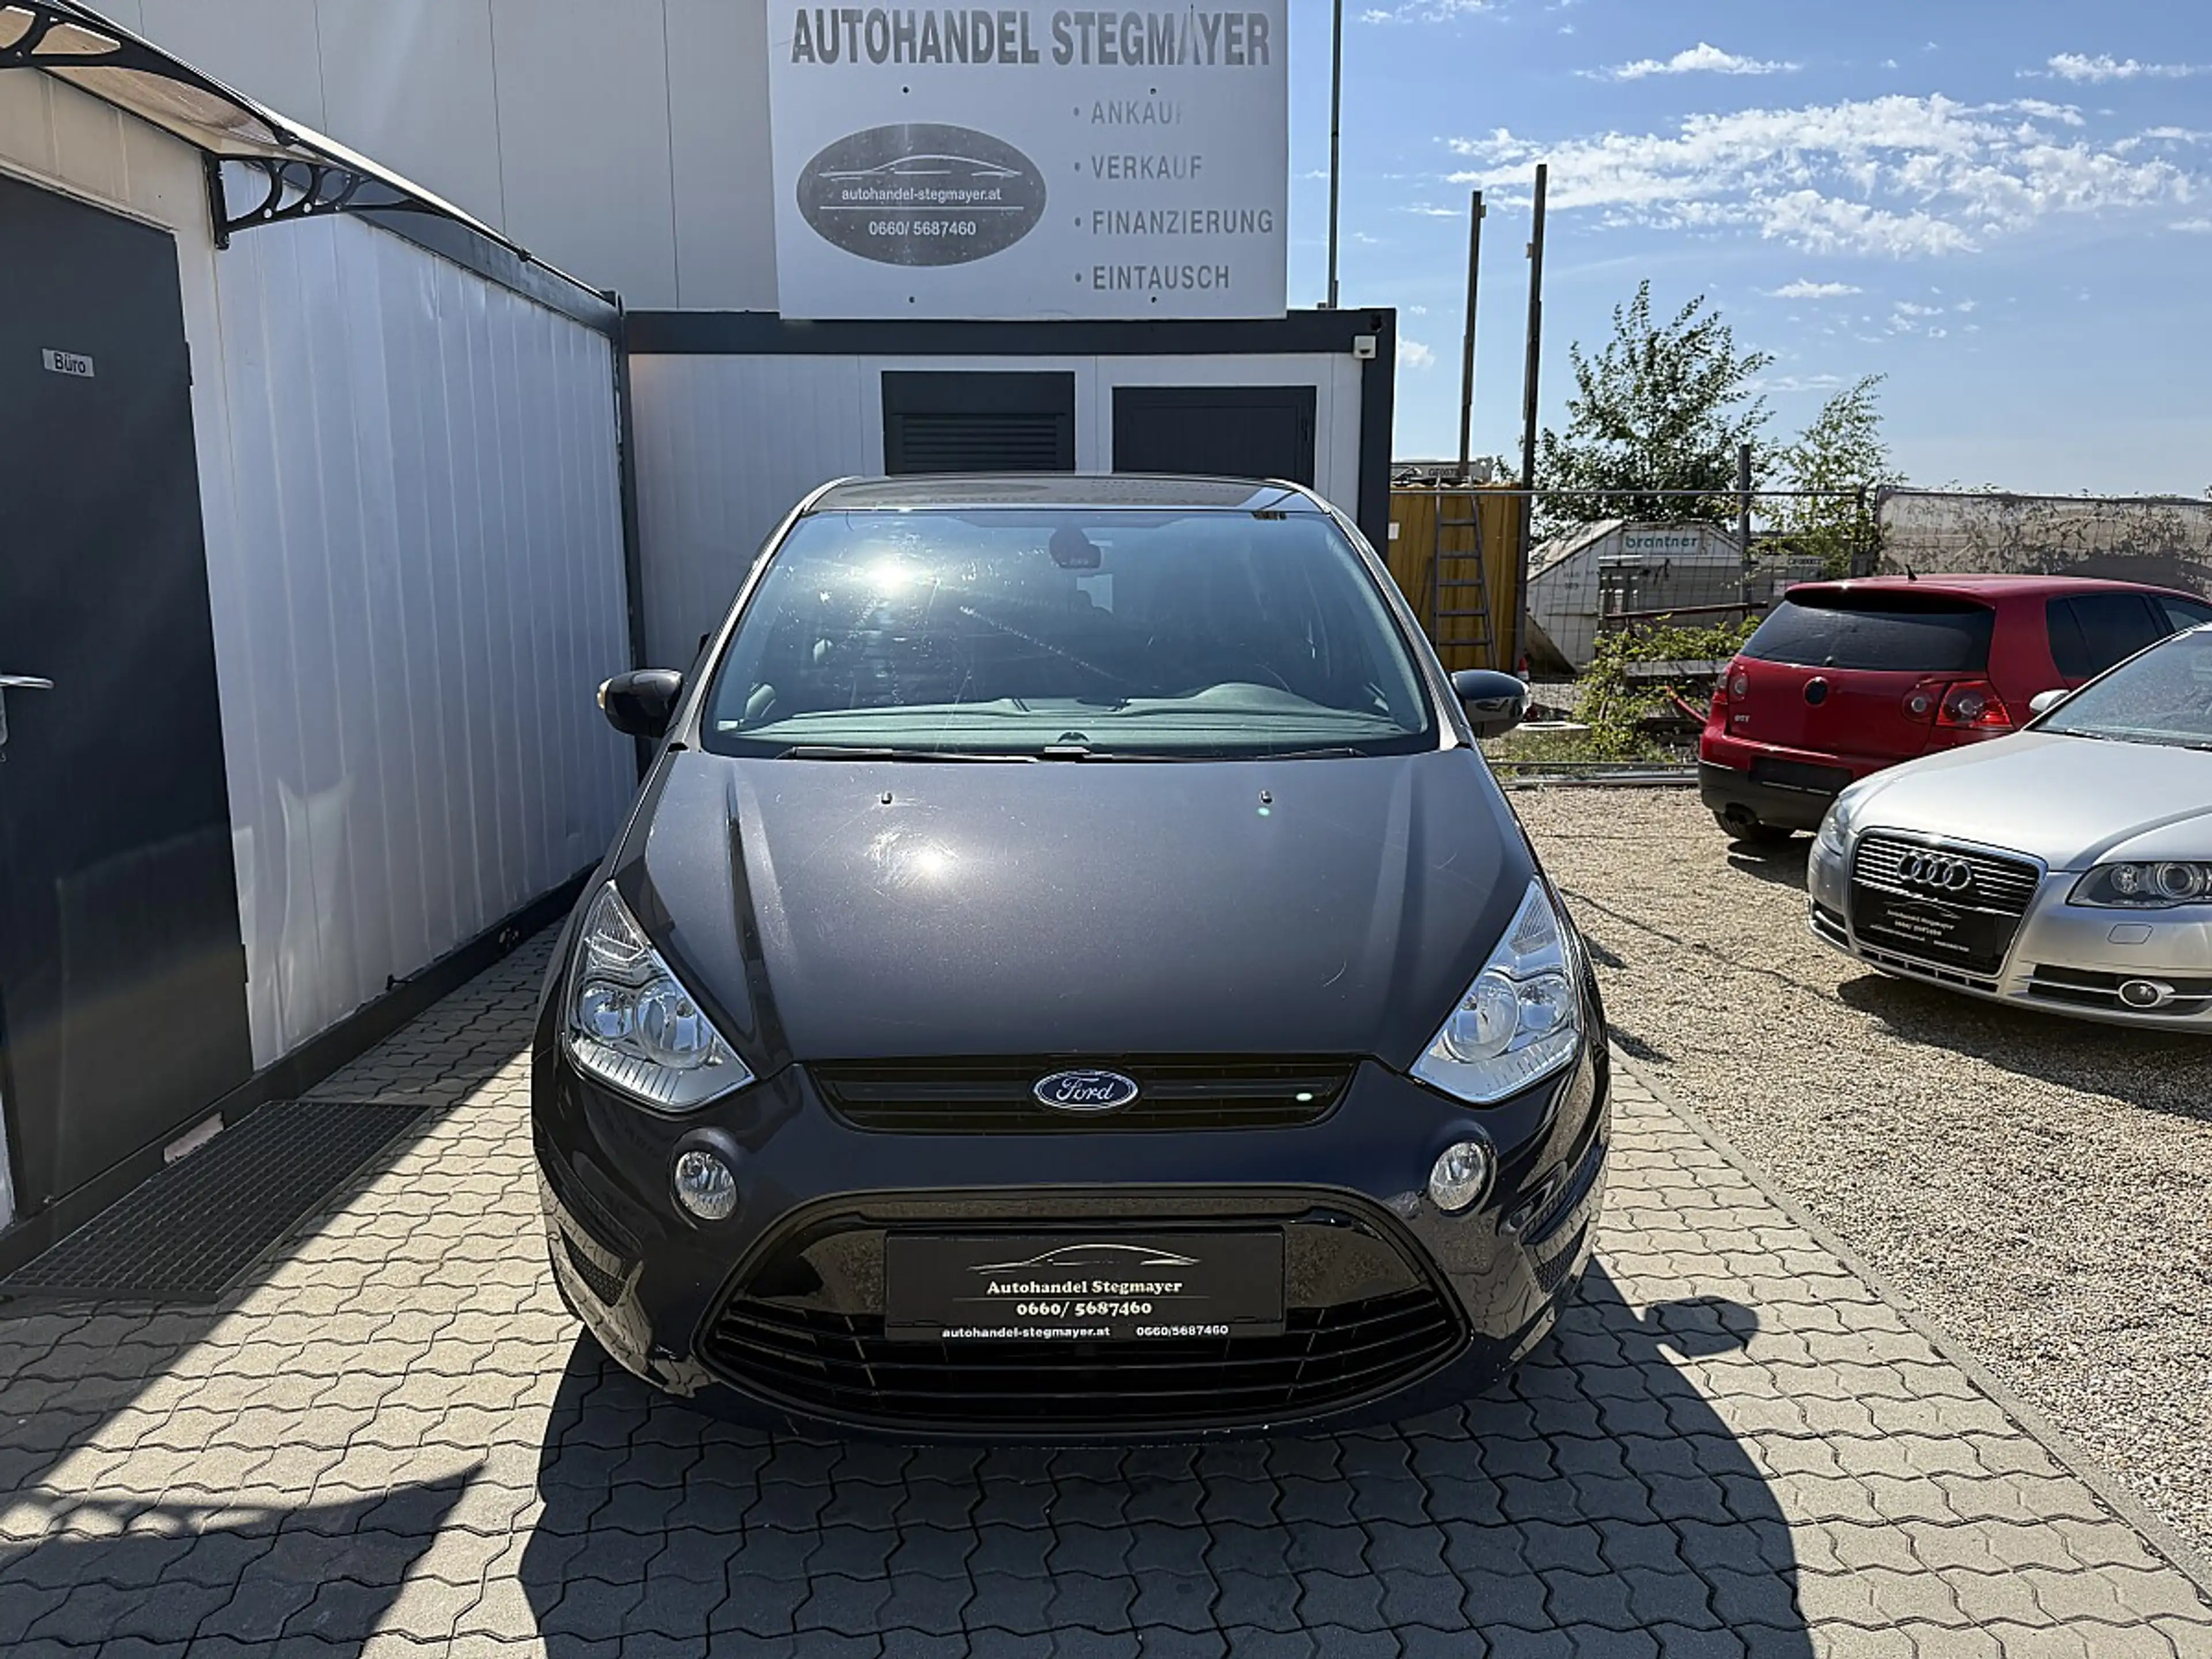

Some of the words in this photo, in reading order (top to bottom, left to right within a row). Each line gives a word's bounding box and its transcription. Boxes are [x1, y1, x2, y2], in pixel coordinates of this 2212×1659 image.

[791, 9, 1039, 65] AUTOHANDEL
[1051, 12, 1270, 66] STEGMAYER
[1092, 155, 1202, 180] VERKAUF
[842, 187, 1002, 203] autohandel-stegmayer.at
[869, 221, 910, 236] 0660/
[913, 221, 976, 237] 5687460
[1092, 210, 1274, 234] FINANZIERUNG
[1093, 266, 1230, 290] EINTAUSCH
[54, 352, 86, 373] Büro
[1626, 536, 1697, 548] brantner
[1056, 1077, 1115, 1101] Ford
[986, 1281, 1088, 1294] Autohandel
[1092, 1281, 1183, 1295] Stegmayer
[1016, 1302, 1070, 1319] 0660/
[1074, 1302, 1152, 1317] 5687460
[942, 1327, 1111, 1339] autohandel-stegmayer.at
